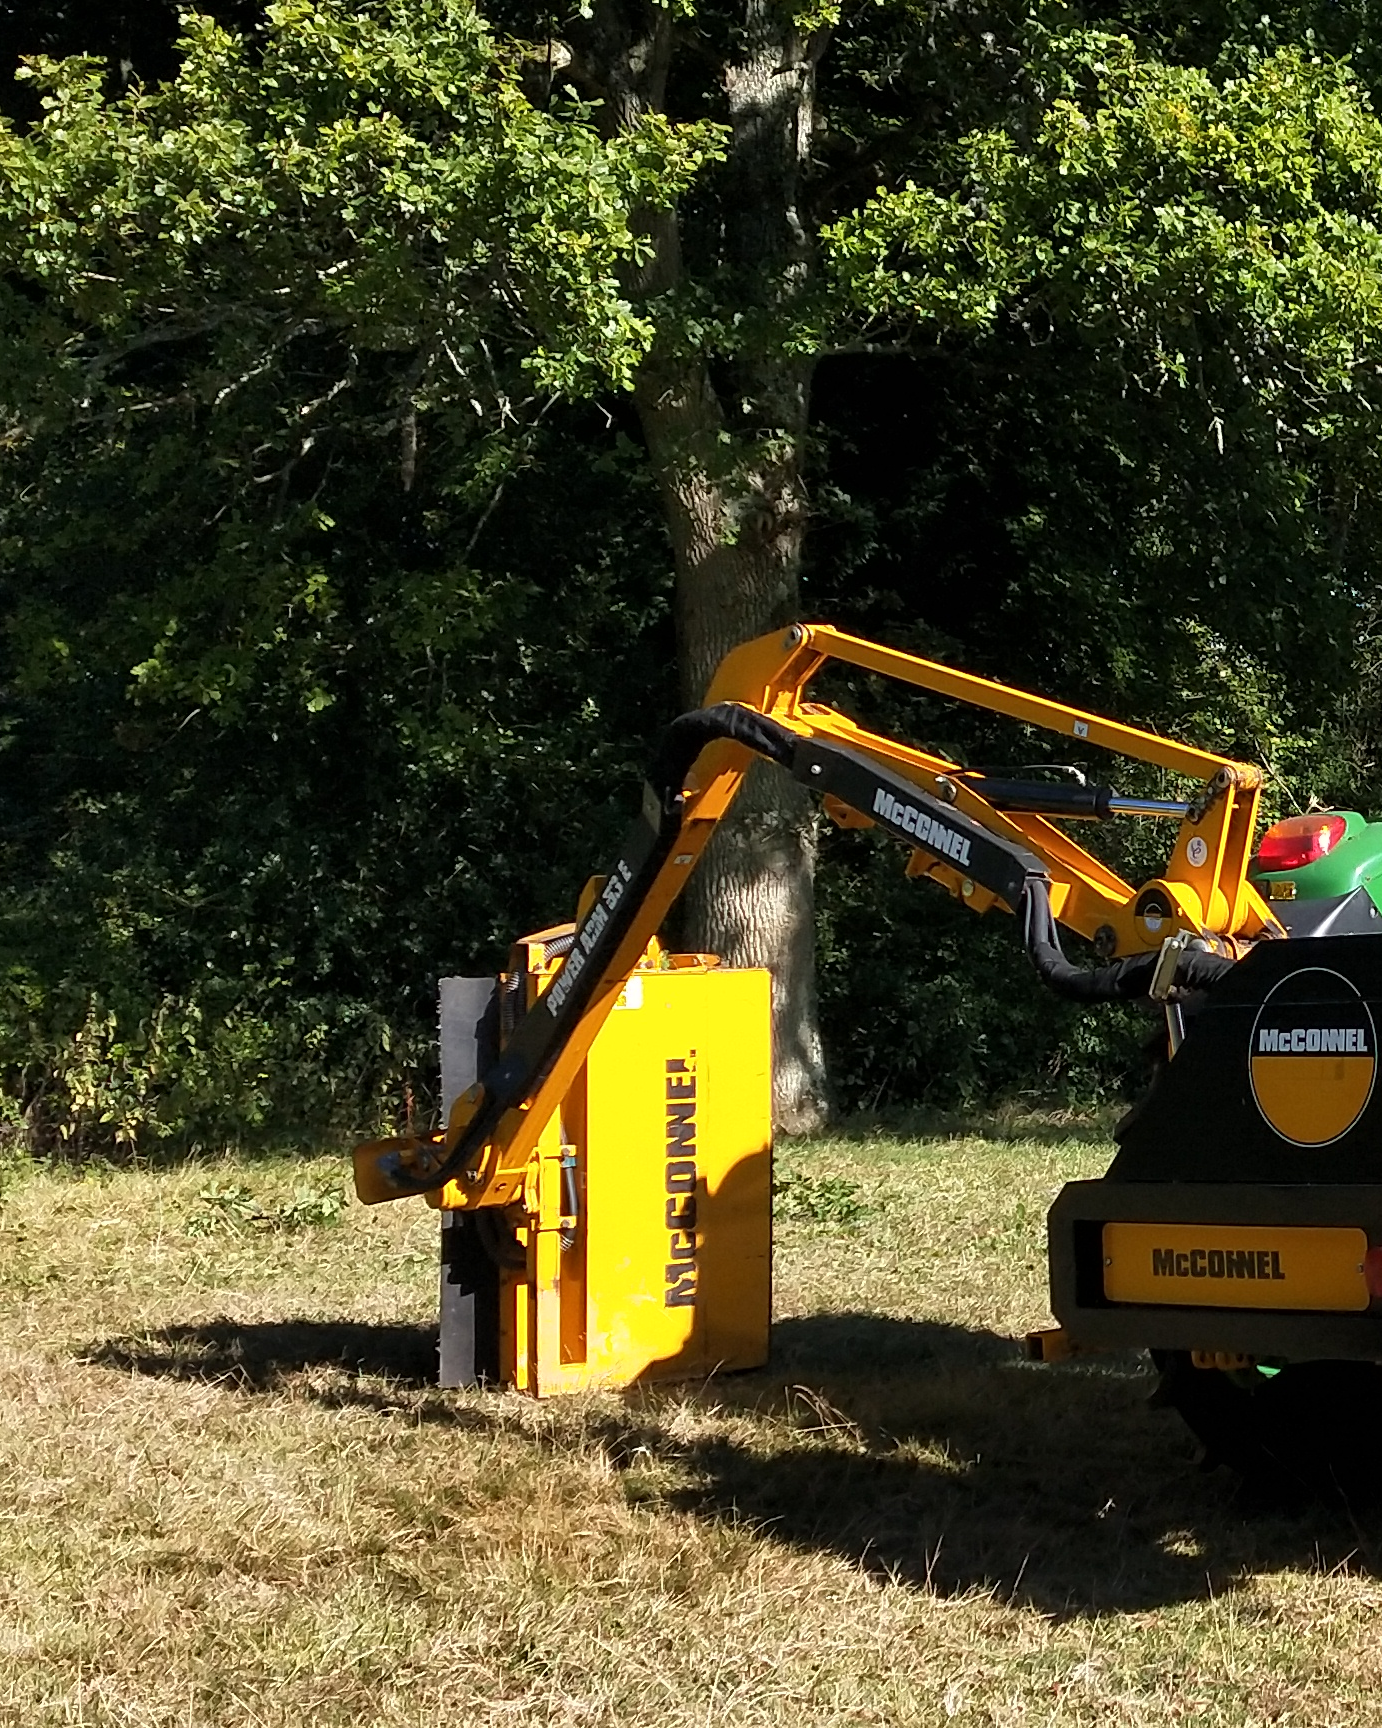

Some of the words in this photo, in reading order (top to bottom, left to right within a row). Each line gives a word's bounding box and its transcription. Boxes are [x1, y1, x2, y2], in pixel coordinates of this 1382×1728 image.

[872, 788, 971, 867] McCONNEL
[546, 947, 586, 1018] POWER
[579, 903, 609, 955] ARM
[617, 859, 632, 883] E
[1259, 1029, 1368, 1052] McCONNEL
[664, 1049, 698, 1307] McCONNEL
[1152, 1248, 1286, 1280] McCONNEL
